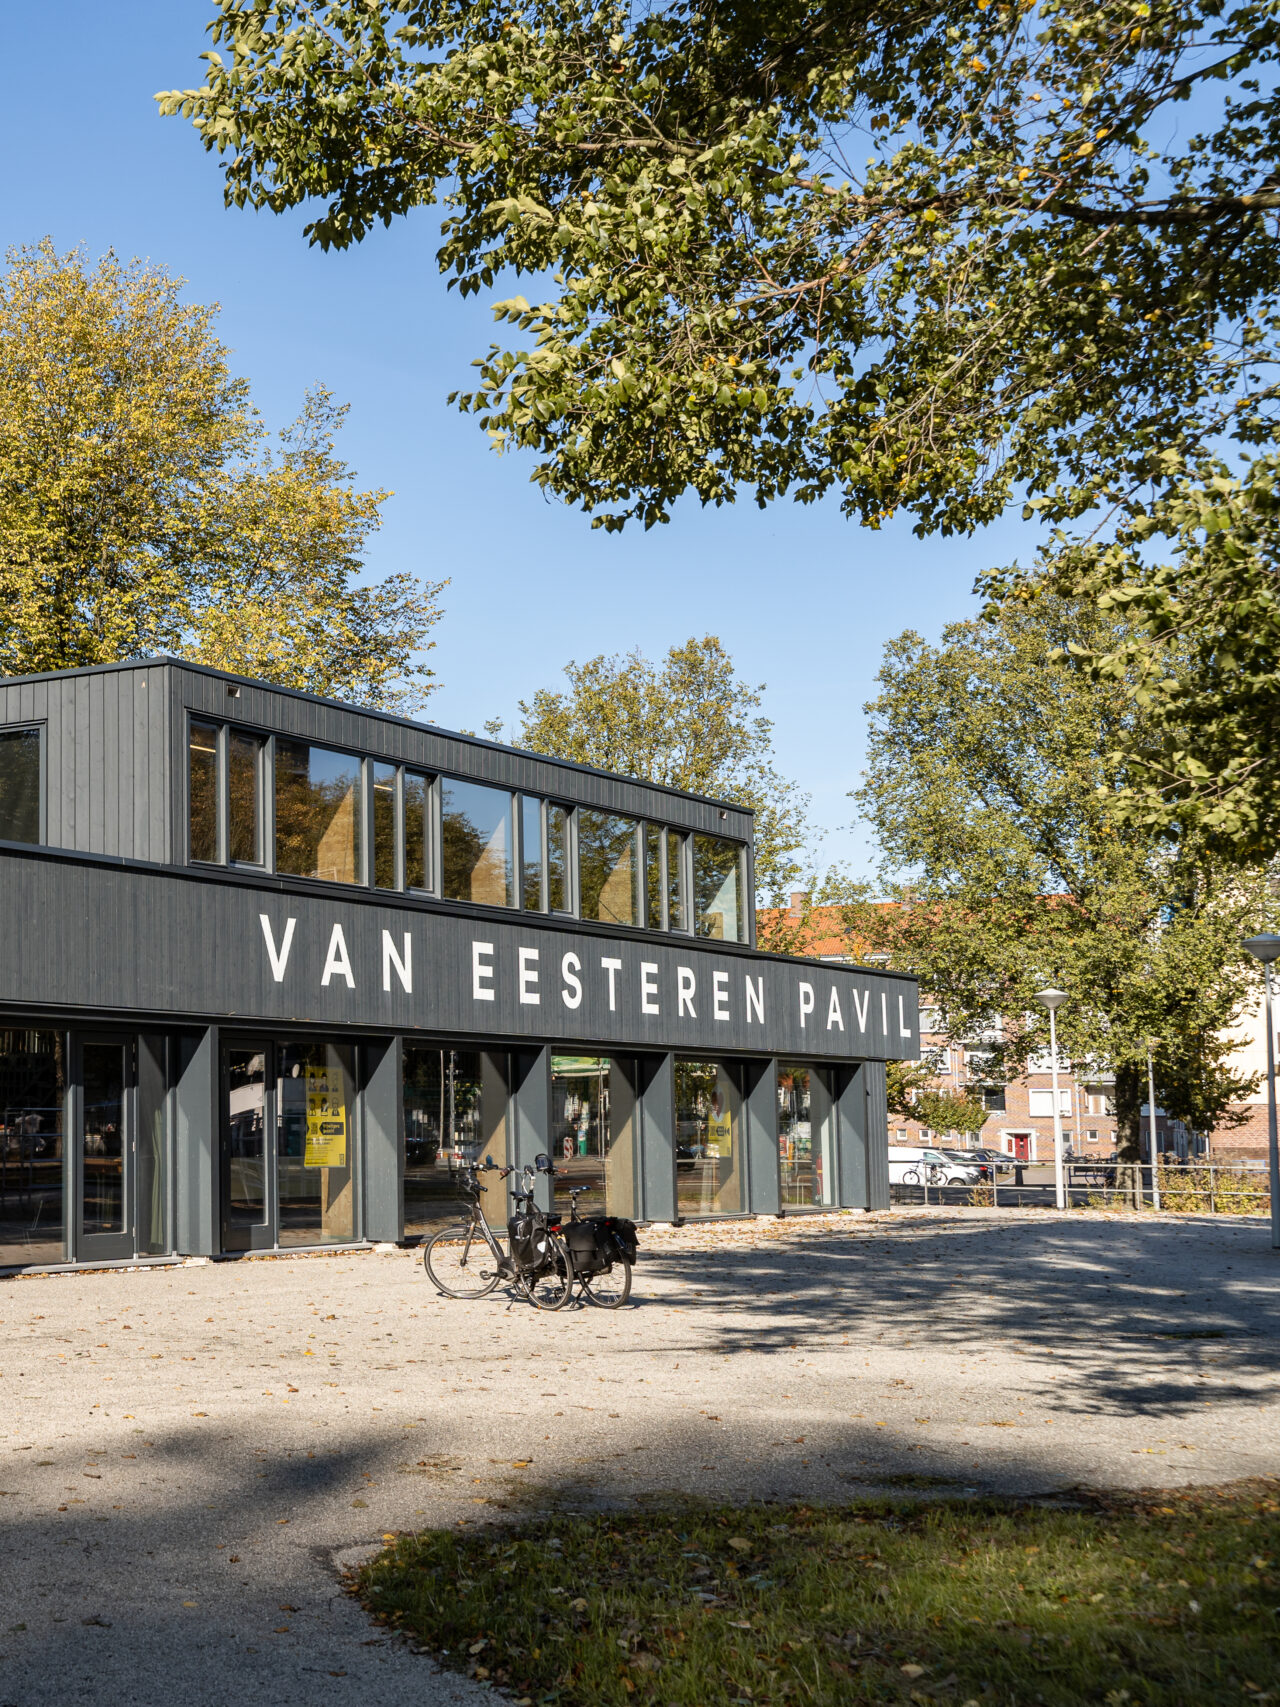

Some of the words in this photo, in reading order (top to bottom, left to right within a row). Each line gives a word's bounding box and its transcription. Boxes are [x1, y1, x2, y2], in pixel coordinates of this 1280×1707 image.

[259, 914, 413, 994] VAN
[472, 942, 765, 1025] EESTEREN
[798, 982, 912, 1039] PAVIL
